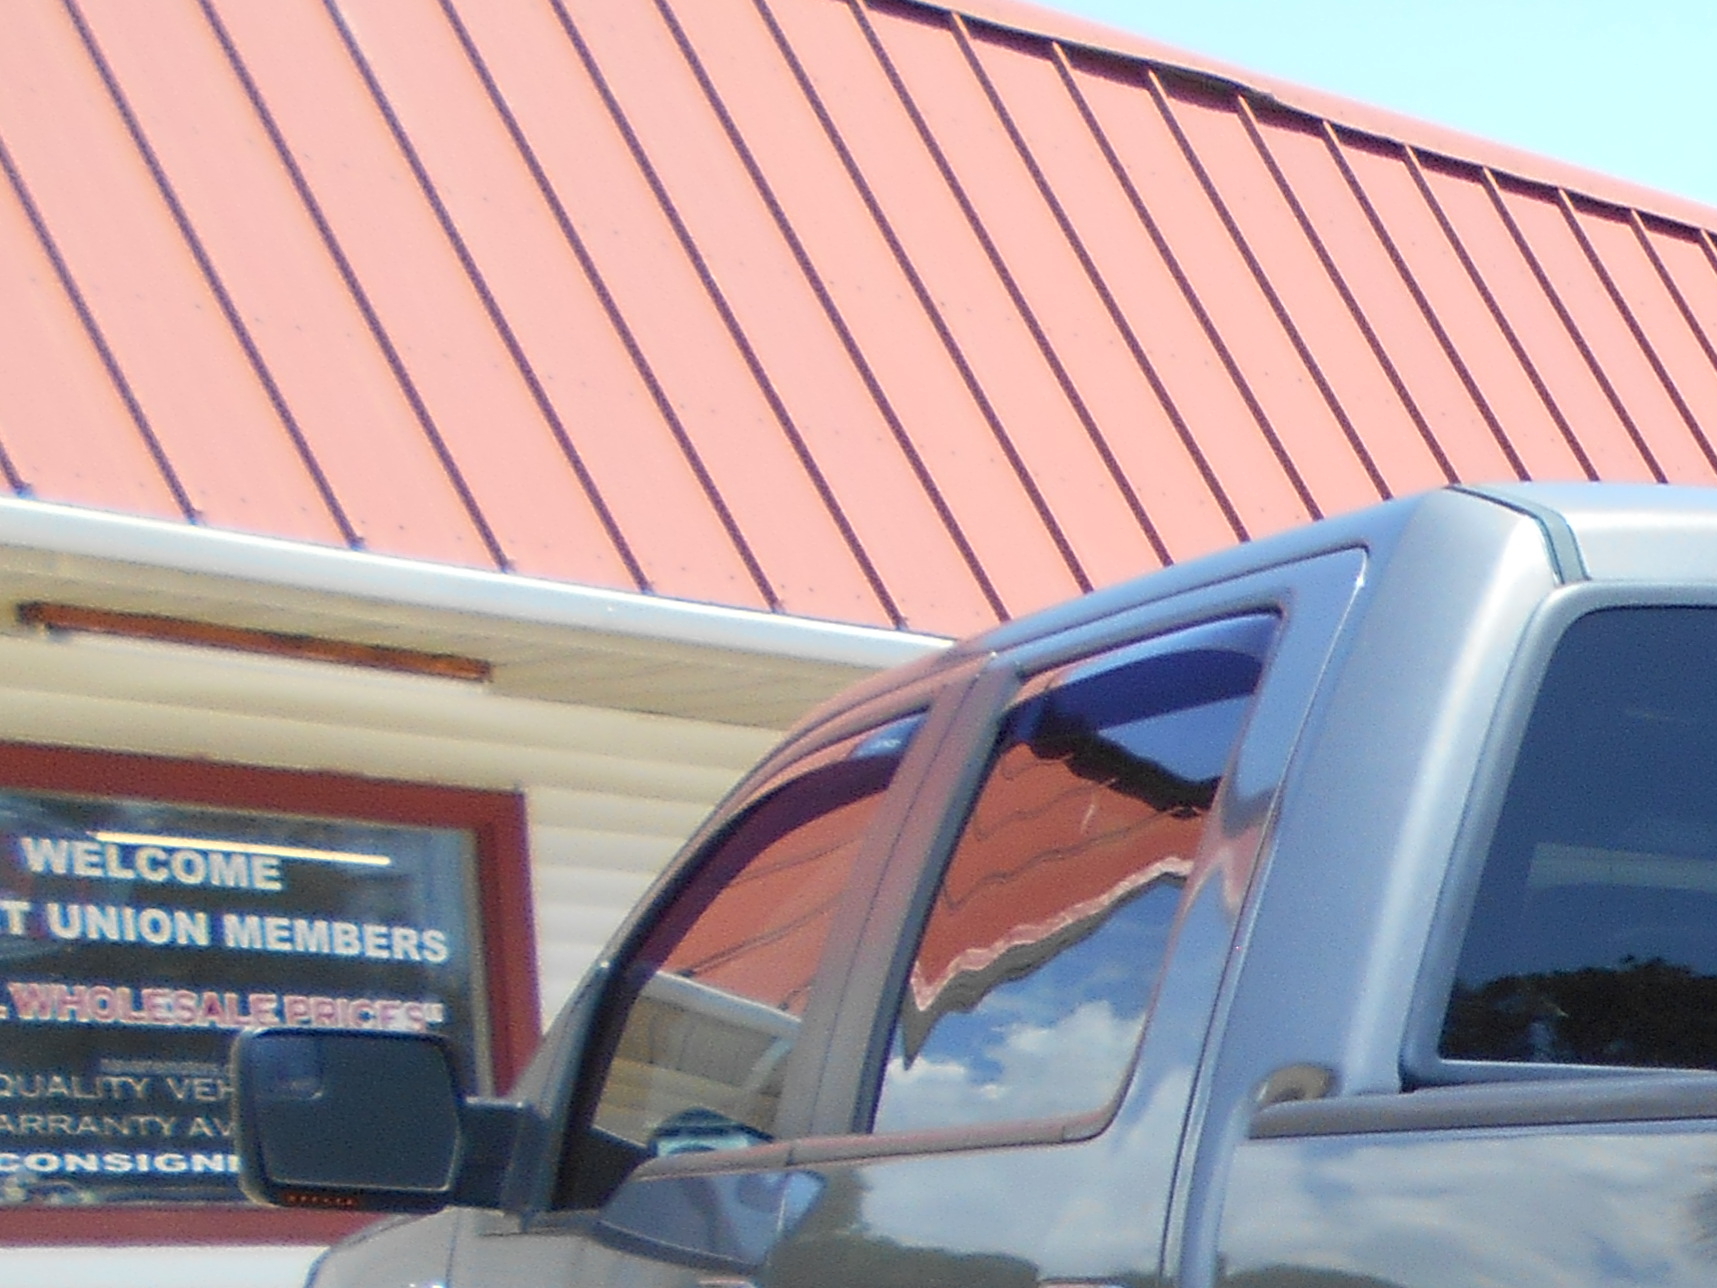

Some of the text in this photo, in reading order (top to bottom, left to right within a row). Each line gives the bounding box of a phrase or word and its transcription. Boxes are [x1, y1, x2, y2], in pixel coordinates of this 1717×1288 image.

[21, 837, 283, 891] WELCOME
[46, 902, 210, 947] UNION
[222, 913, 451, 964] MEMBERS
[7, 981, 278, 1028] WHOLESALE
